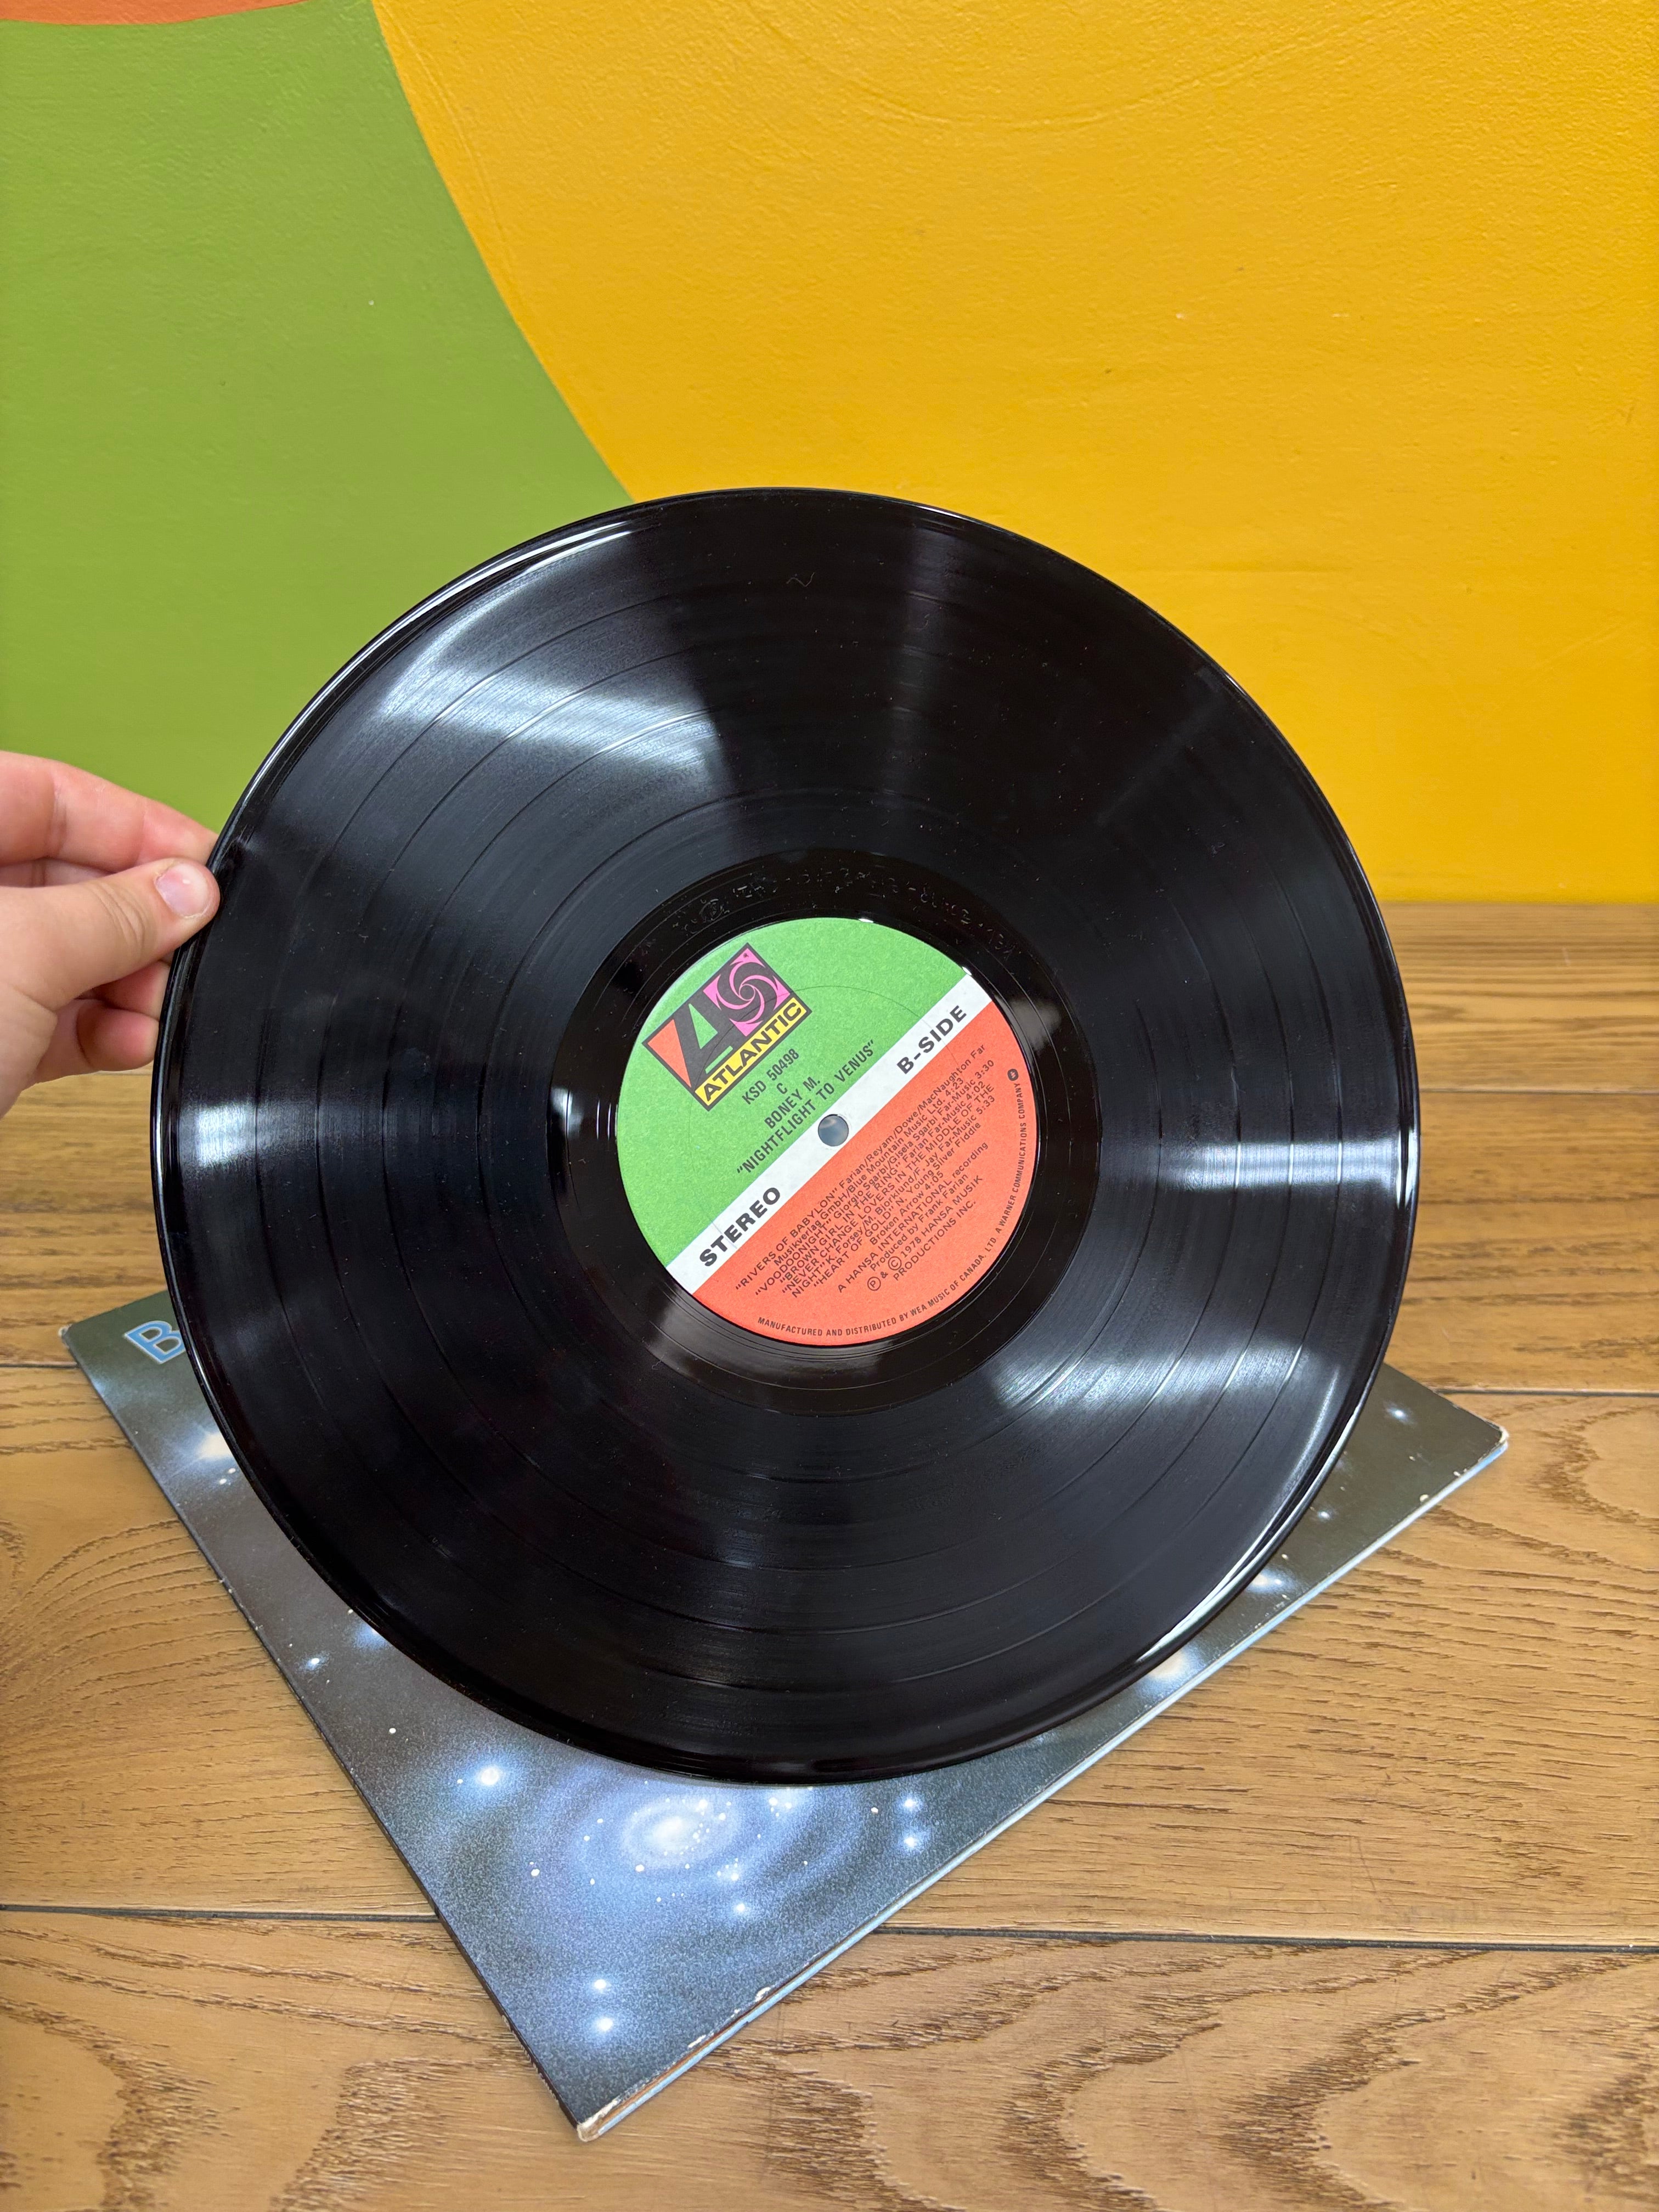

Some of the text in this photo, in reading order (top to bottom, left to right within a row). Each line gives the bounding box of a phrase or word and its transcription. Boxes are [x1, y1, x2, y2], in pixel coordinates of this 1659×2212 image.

[704, 1002, 802, 1102] ATLANTIC
[742, 1048, 799, 1105] KSD 50498
[776, 1082, 788, 1094] C
[699, 1005, 967, 1266] STEREO B-SIDE
[737, 1039, 873, 1173] "NIGHTFLIGHT TO VENUS"
[764, 1076, 820, 1129] BONEY M.
[925, 1152, 938, 1167] Jay
[938, 1115, 977, 1152] Far-Music
[976, 1095, 995, 1114] 5:33
[1014, 1083, 1026, 1119] COMPANY
[736, 1251, 776, 1290] "RIVERS
[776, 1237, 788, 1251] OF
[789, 1187, 837, 1238] BABYLON"
[970, 1045, 985, 1059] Far
[755, 1218, 831, 1295] "VOODOONIGHT"
[833, 1190, 865, 1218] Giorgio
[913, 1115, 938, 1141] Sgarbi
[937, 1080, 975, 1116] Far-Music
[975, 1060, 994, 1079] 3:30
[774, 1220, 822, 1266] Musikverlag
[866, 1138, 904, 1174] Mountain
[903, 1115, 927, 1137] Music
[927, 1098, 945, 1114] Ltd.
[945, 1077, 963, 1097] 4:23
[780, 1081, 985, 1283] "BROWN GIRL IN THE RING" Farian Far-Music 4:02
[782, 1084, 994, 1293] "NEVER CHANGE LOVERS IN THE MIDDLE OF THE
[1012, 1122, 1028, 1193] COMMUNICATIONS
[814, 1251, 849, 1287] "HEART
[851, 1237, 862, 1251] OF
[865, 1206, 894, 1237] GOLD"
[906, 1170, 934, 1193] Young
[933, 1148, 955, 1170] Silver
[955, 1122, 981, 1147] Fiddle
[838, 1142, 988, 1293] A HANSA INTERNATIONAL recording
[870, 1171, 943, 1245] Broken Arrow 4:05
[870, 1175, 968, 1271] Produced by Frank Farian
[893, 1201, 976, 1281] PRODUCTIONS INC.
[900, 1237, 921, 1257] 1978
[921, 1206, 953, 1237] HANSA
[952, 1175, 983, 1205] MUSIK
[998, 1195, 1017, 1227] WARNER
[899, 1312, 909, 1322] BY
[910, 1304, 928, 1317] WEA
[928, 1289, 950, 1308] MUSIC
[950, 1280, 960, 1291] OF
[758, 1317, 823, 1336] MANUFACTURED
[846, 1317, 897, 1336] DISTRIBUTED
